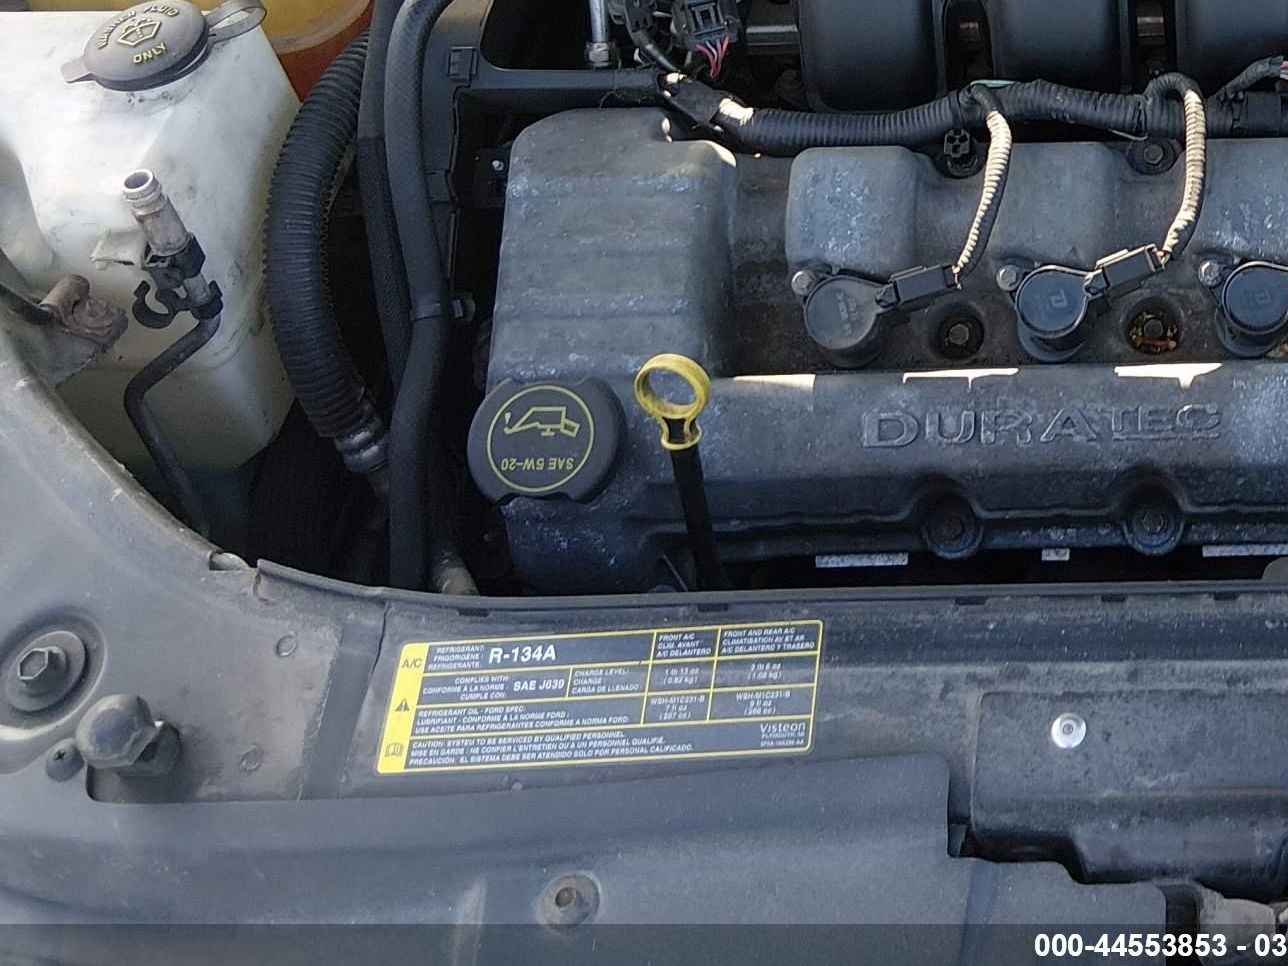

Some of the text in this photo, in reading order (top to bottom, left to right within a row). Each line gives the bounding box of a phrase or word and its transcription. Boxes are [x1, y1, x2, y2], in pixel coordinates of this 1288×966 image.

[143, 4, 180, 17] FLUID
[132, 42, 168, 64] ONLY
[861, 404, 1222, 447] DURATEC
[501, 457, 574, 471] SAE 5W-20
[669, 648, 712, 657] DELANTERO
[735, 644, 775, 653] DELANTERO
[782, 641, 814, 650] TRASERO
[488, 644, 556, 664] R-134A
[402, 658, 424, 668] A/C
[454, 676, 489, 684] COMPLIES
[574, 670, 604, 678] CHARGE
[422, 687, 462, 695] CONFORME
[479, 684, 504, 692] NORME
[514, 679, 565, 691] SAE J639
[460, 693, 489, 701] CUMPLE
[418, 708, 467, 717] REFRIGERANT
[484, 706, 504, 714] FORD
[417, 718, 457, 726] LUBRIFIANT
[430, 726, 455, 734] ACEITE
[476, 722, 534, 731] REFRIGERANTES
[534, 720, 574, 728] CONFORME
[582, 716, 608, 724] NORMA
[760, 722, 806, 733] Visteon
[446, 739, 476, 747] SYSTEM
[498, 736, 532, 744] SERVICED
[544, 734, 582, 742] QUALIFIED
[429, 748, 440, 756] EN
[441, 748, 464, 756] GARDE
[470, 746, 480, 754] NE
[481, 745, 512, 754] CONFIER
[576, 740, 587, 748] UN
[588, 738, 630, 748] PERSONNEL
[460, 756, 468, 764] EL
[470, 754, 500, 762] SISTEMA
[502, 753, 520, 761] DEBE
[522, 752, 536, 760] SER
[537, 750, 572, 759] ATENDIDO
[594, 748, 611, 756] POR
[612, 745, 649, 754] PERSONAL
